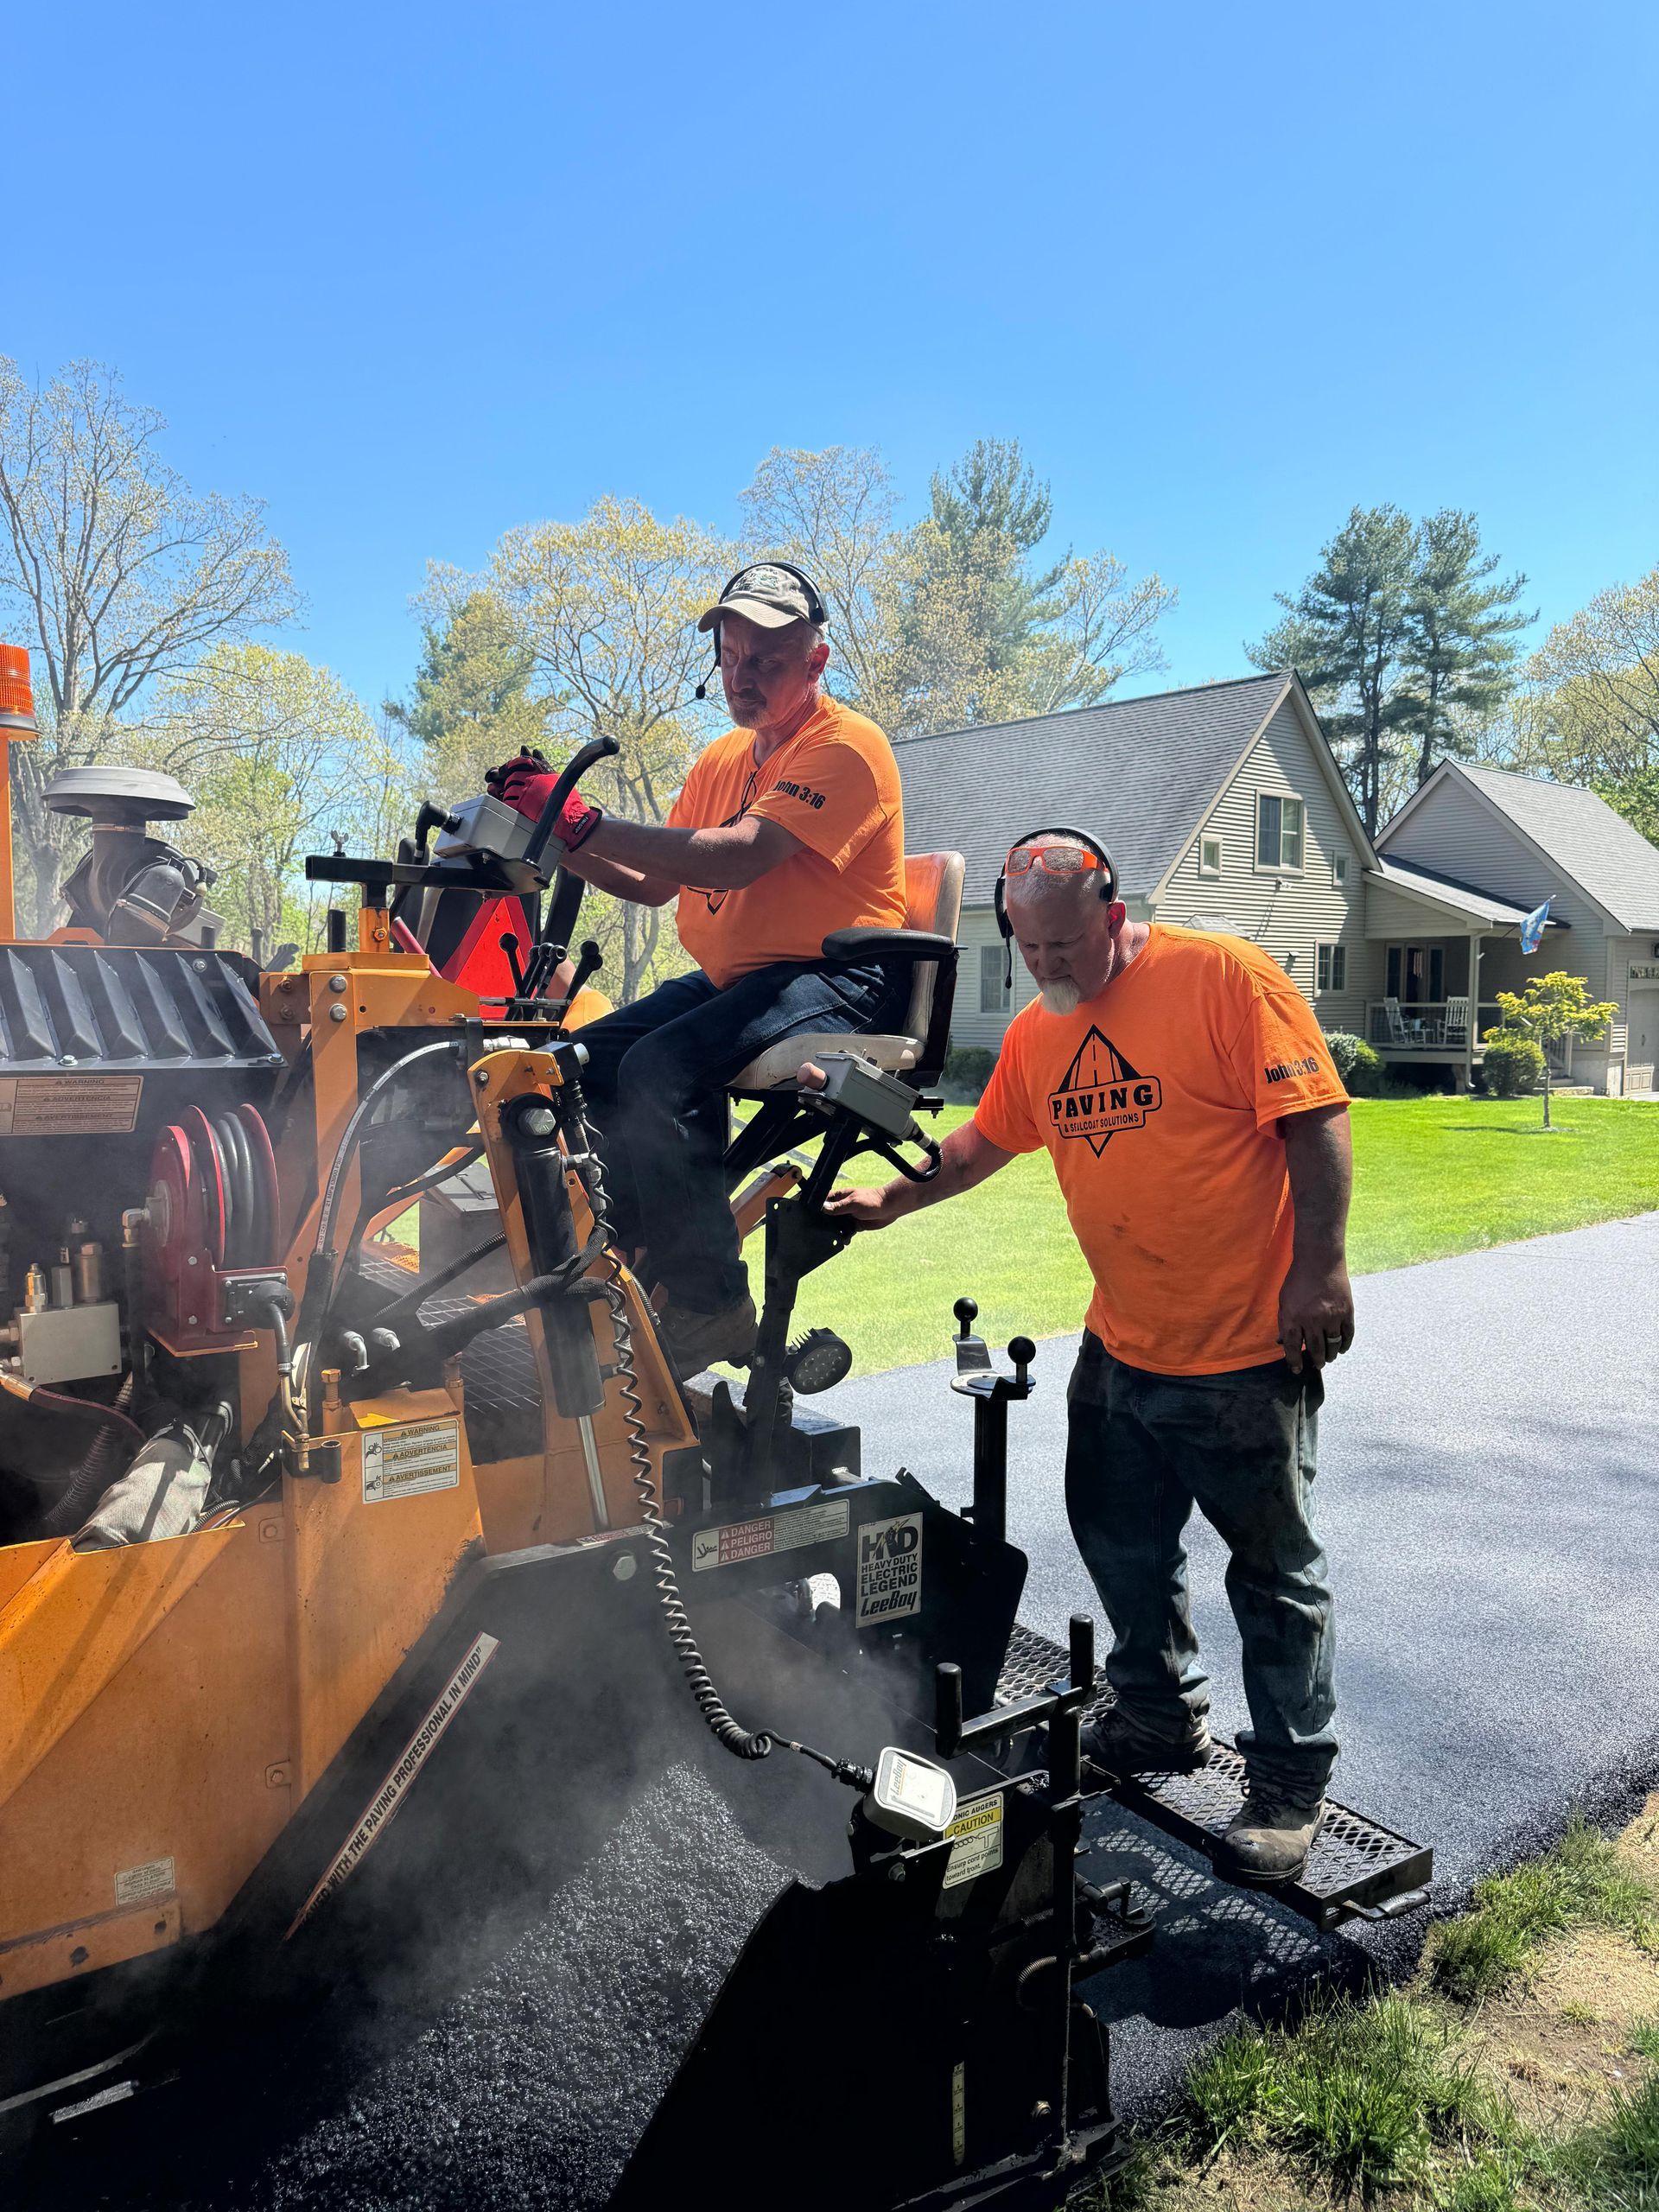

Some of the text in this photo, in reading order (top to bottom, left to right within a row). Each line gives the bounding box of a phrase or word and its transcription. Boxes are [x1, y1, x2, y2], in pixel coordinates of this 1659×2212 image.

[773, 779, 826, 810] John 3:16
[1264, 1057, 1319, 1084] John 3:16
[1052, 1084, 1154, 1120] PAVING
[1064, 1123, 1069, 1133] &
[1100, 1113, 1139, 1128] SOLUTIONS
[407, 1425, 440, 1435] WARNING
[399, 1444, 448, 1458] ADVERTENCIA
[396, 1465, 451, 1481] AVERTISSEMENT
[731, 1521, 771, 1536] DANGER
[731, 1531, 772, 1548] PELIGRO
[731, 1541, 771, 1559] DANGER
[861, 1553, 918, 1573] HEAVY DUTY
[861, 1562, 918, 1585] ELECTRIC
[861, 1573, 918, 1597] LEGEND
[860, 1590, 918, 1617] LeeBoy
[327, 1853, 353, 1887] WITH
[348, 1829, 369, 1857] THE
[365, 1784, 396, 1833] PAVING
[392, 1700, 452, 1789] PROFESSIONAL
[448, 1682, 461, 1703] IN
[890, 1758, 907, 1796] LeeBoy
[952, 1800, 998, 1821] ONIC AUGERS
[953, 1812, 994, 1834] CAUTION
[946, 1848, 999, 1872] Ensure cord points
[946, 1869, 966, 1881] toward
